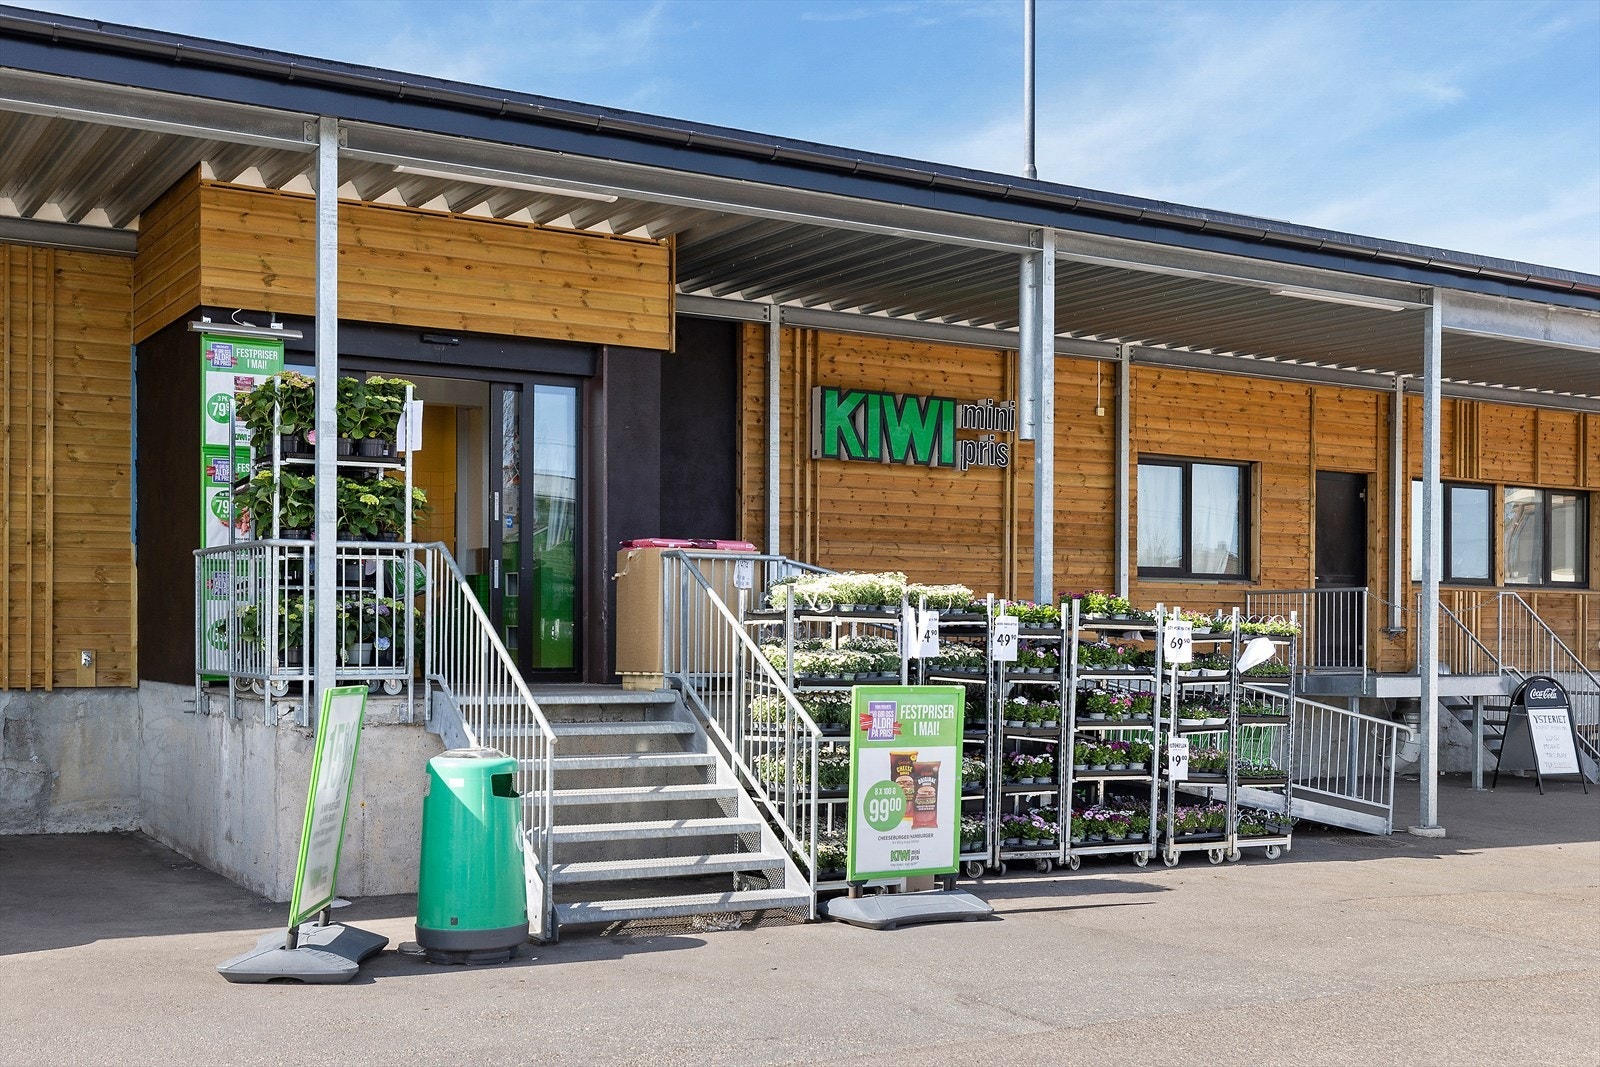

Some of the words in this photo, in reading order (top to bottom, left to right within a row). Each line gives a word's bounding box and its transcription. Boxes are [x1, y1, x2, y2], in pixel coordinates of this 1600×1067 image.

[236, 348, 278, 360] FESTPRISER
[251, 360, 267, 369] MAI!
[821, 386, 957, 467] KIWI
[962, 398, 1016, 431] mini
[961, 434, 1011, 471] pris
[215, 500, 229, 514] 79
[922, 629, 937, 642] 490
[900, 704, 954, 719] FESTPRISER
[872, 717, 894, 729] ALDRI
[1533, 715, 1566, 724] YSTERIET
[913, 721, 917, 736] I
[919, 721, 940, 736] MAI!
[874, 787, 878, 795] 8
[879, 787, 883, 795] X
[883, 787, 892, 795] 100
[890, 849, 911, 862] KIWI
